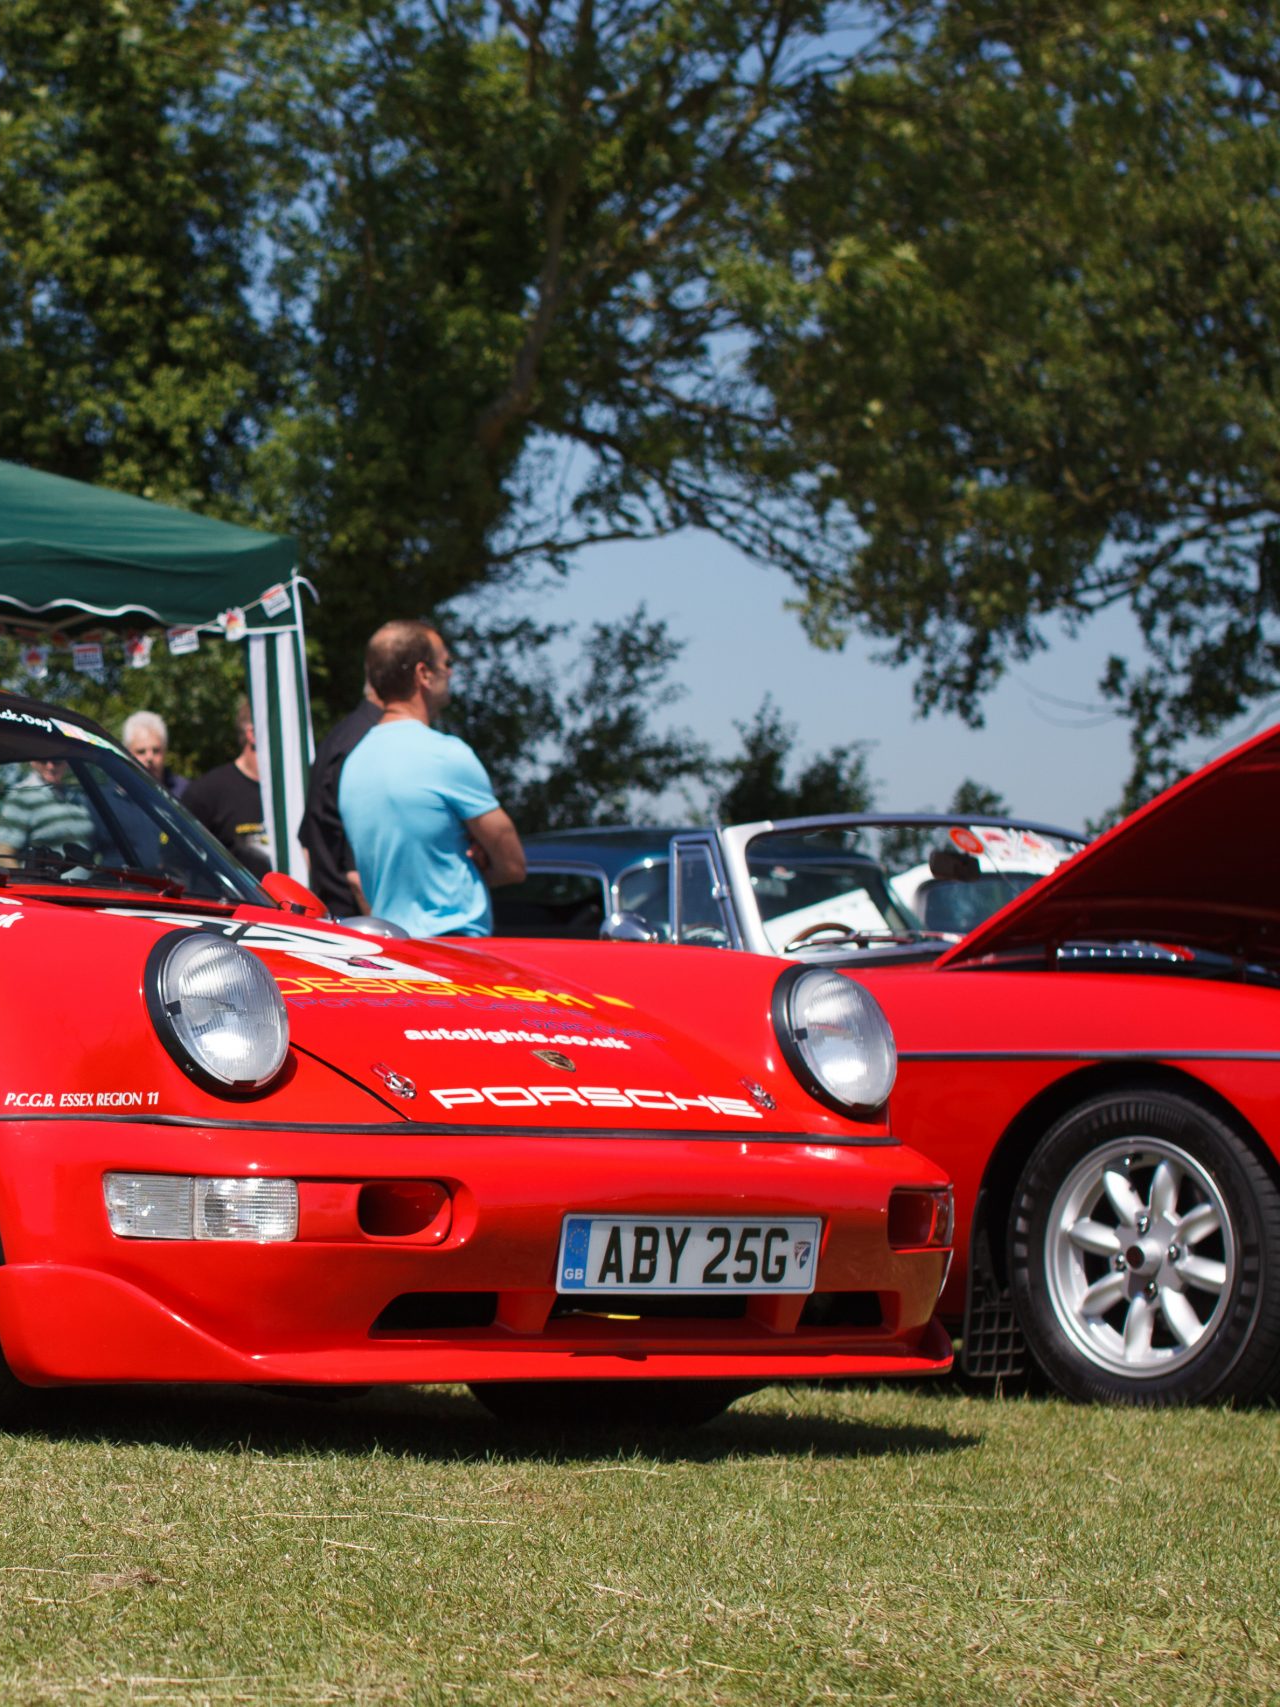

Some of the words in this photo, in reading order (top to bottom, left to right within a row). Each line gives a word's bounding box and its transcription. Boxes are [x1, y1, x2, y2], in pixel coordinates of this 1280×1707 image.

[22, 714, 53, 733] Day
[404, 1028, 631, 1051] autolights.co.uk
[4, 1092, 56, 1108] P.C.G.B.
[60, 1093, 93, 1107] ESSEX
[96, 1092, 143, 1107] REGION
[147, 1091, 160, 1105] 11
[430, 1085, 764, 1120] PORSCHE
[597, 1226, 691, 1284] ABY
[702, 1227, 789, 1284] 25G
[564, 1268, 584, 1281] GB
